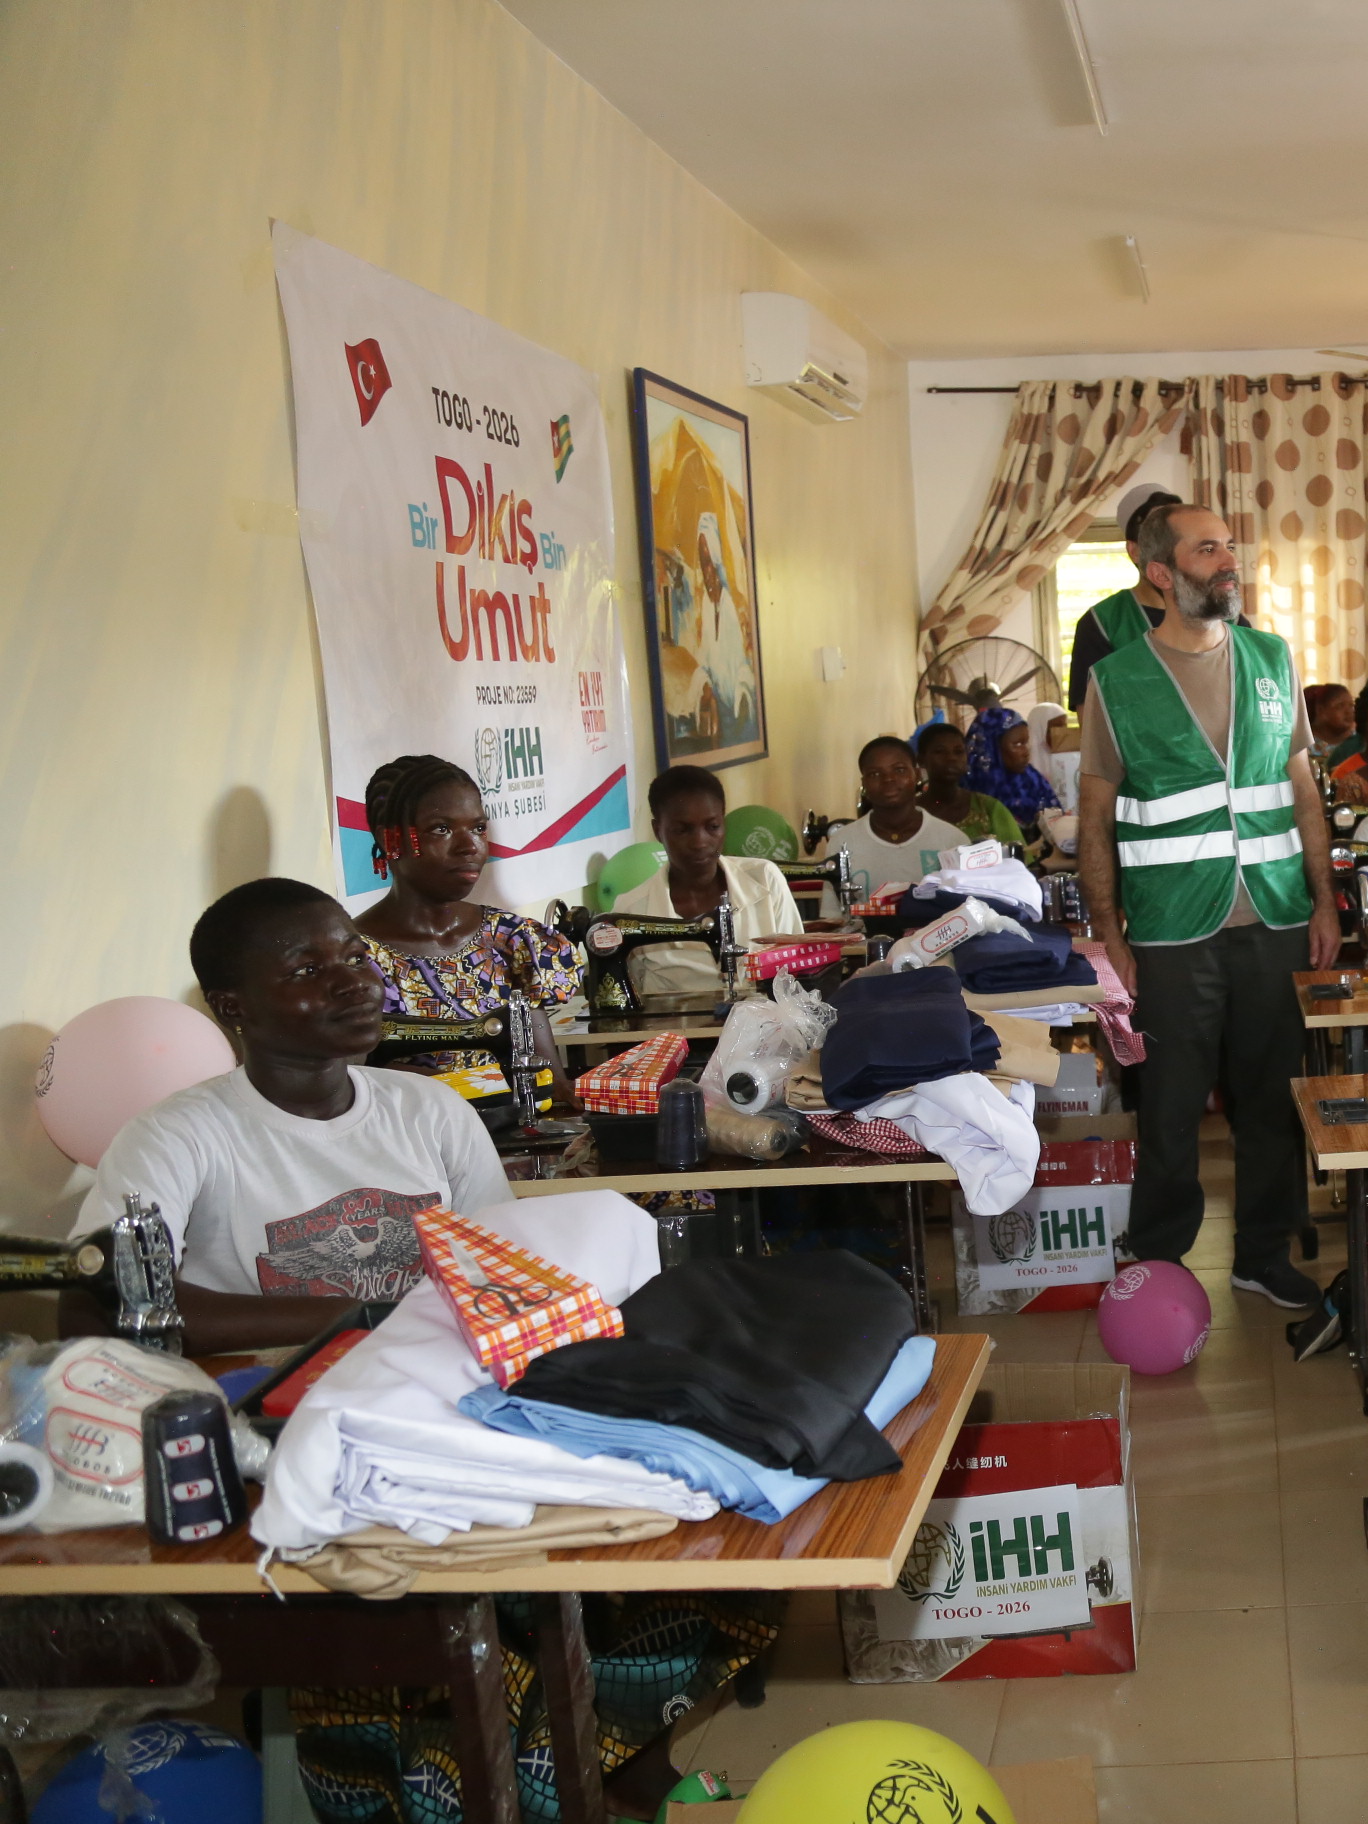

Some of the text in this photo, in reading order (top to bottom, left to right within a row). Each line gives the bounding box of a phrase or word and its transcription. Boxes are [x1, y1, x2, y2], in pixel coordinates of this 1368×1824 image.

[431, 386, 473, 433] TOGO
[483, 405, 520, 448] 2026
[407, 455, 567, 575] Bir Dikiş Bin
[435, 561, 556, 664] Umut
[475, 685, 537, 705] PROJE NO: 23559
[578, 671, 591, 706] EN
[484, 790, 546, 821] ONYA ŞUBESİ
[1037, 1101, 1089, 1113] FLYINGMAN
[350, 1206, 386, 1221] YEARS
[1015, 1267, 1047, 1277] TOGO
[1057, 1264, 1078, 1275] 2026
[1009, 1578, 1048, 1594] YARDIM
[1049, 1575, 1077, 1589] VAKFI
[931, 1606, 983, 1621] TOGO
[996, 1600, 1031, 1616] 2026
